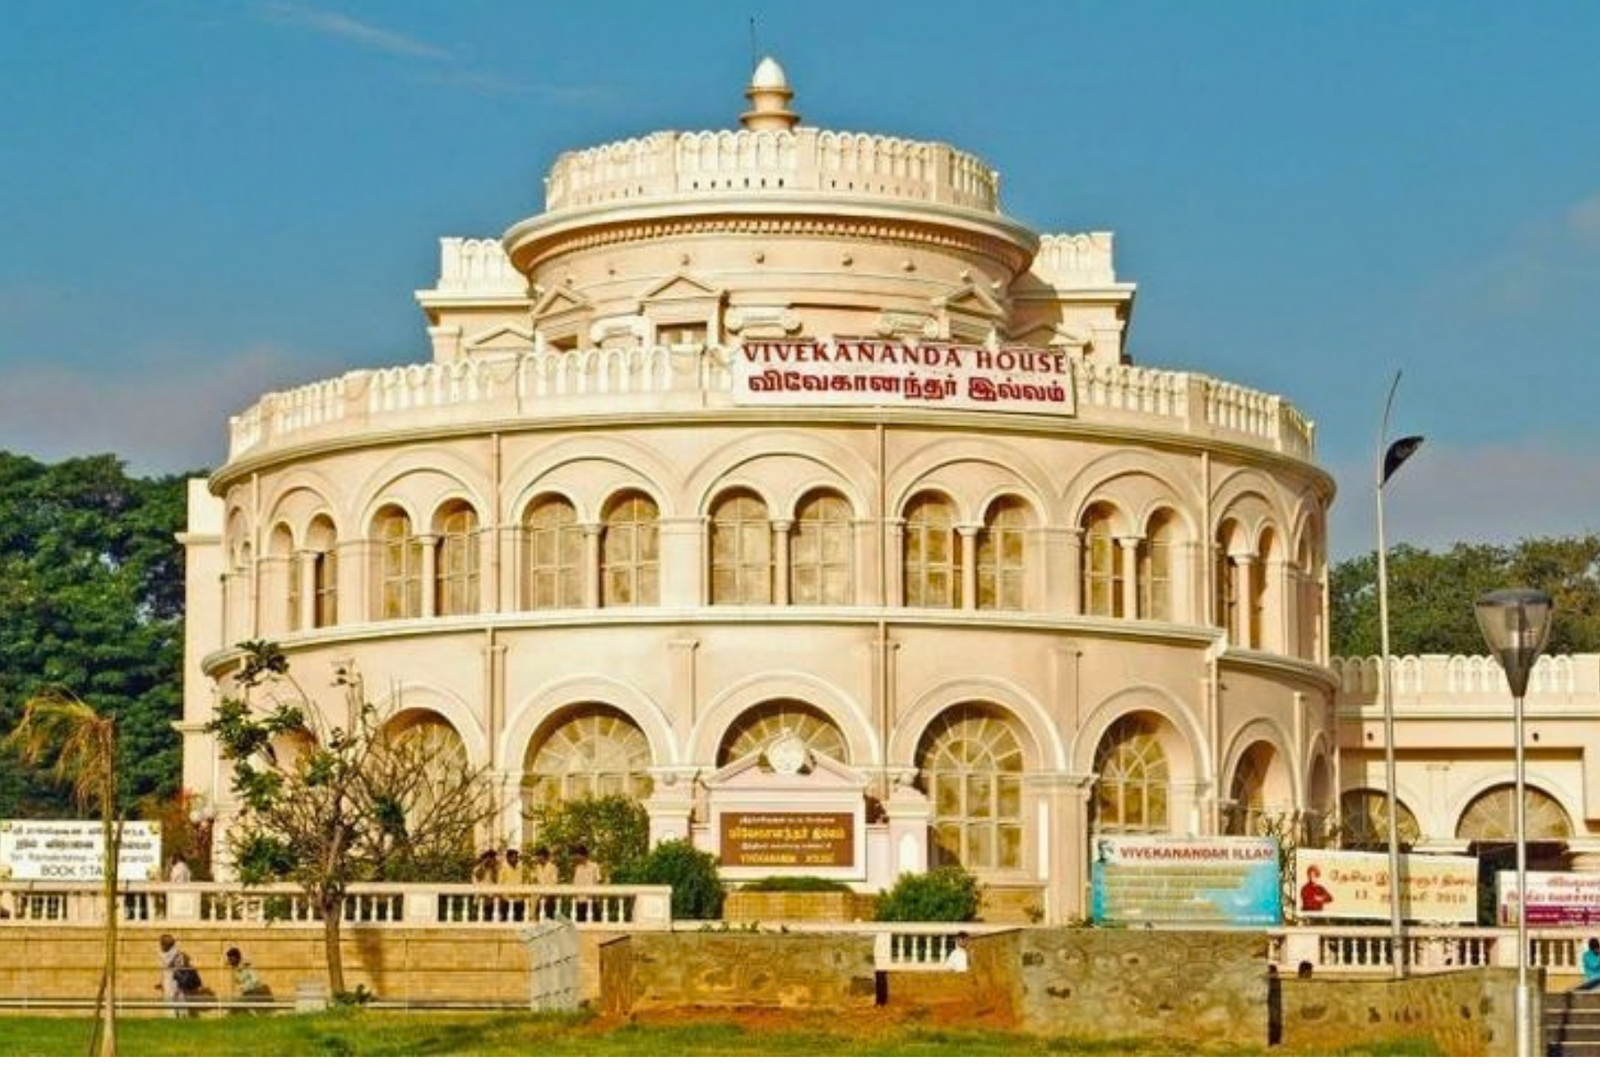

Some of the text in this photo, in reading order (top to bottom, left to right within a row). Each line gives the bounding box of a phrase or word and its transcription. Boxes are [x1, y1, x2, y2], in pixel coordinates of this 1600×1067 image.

[742, 342, 1067, 374] VIVEKANANDA HOUSE
[749, 369, 1065, 402] விவேகானந்தர் இல்லம்
[41, 865, 76, 876] BOOK
